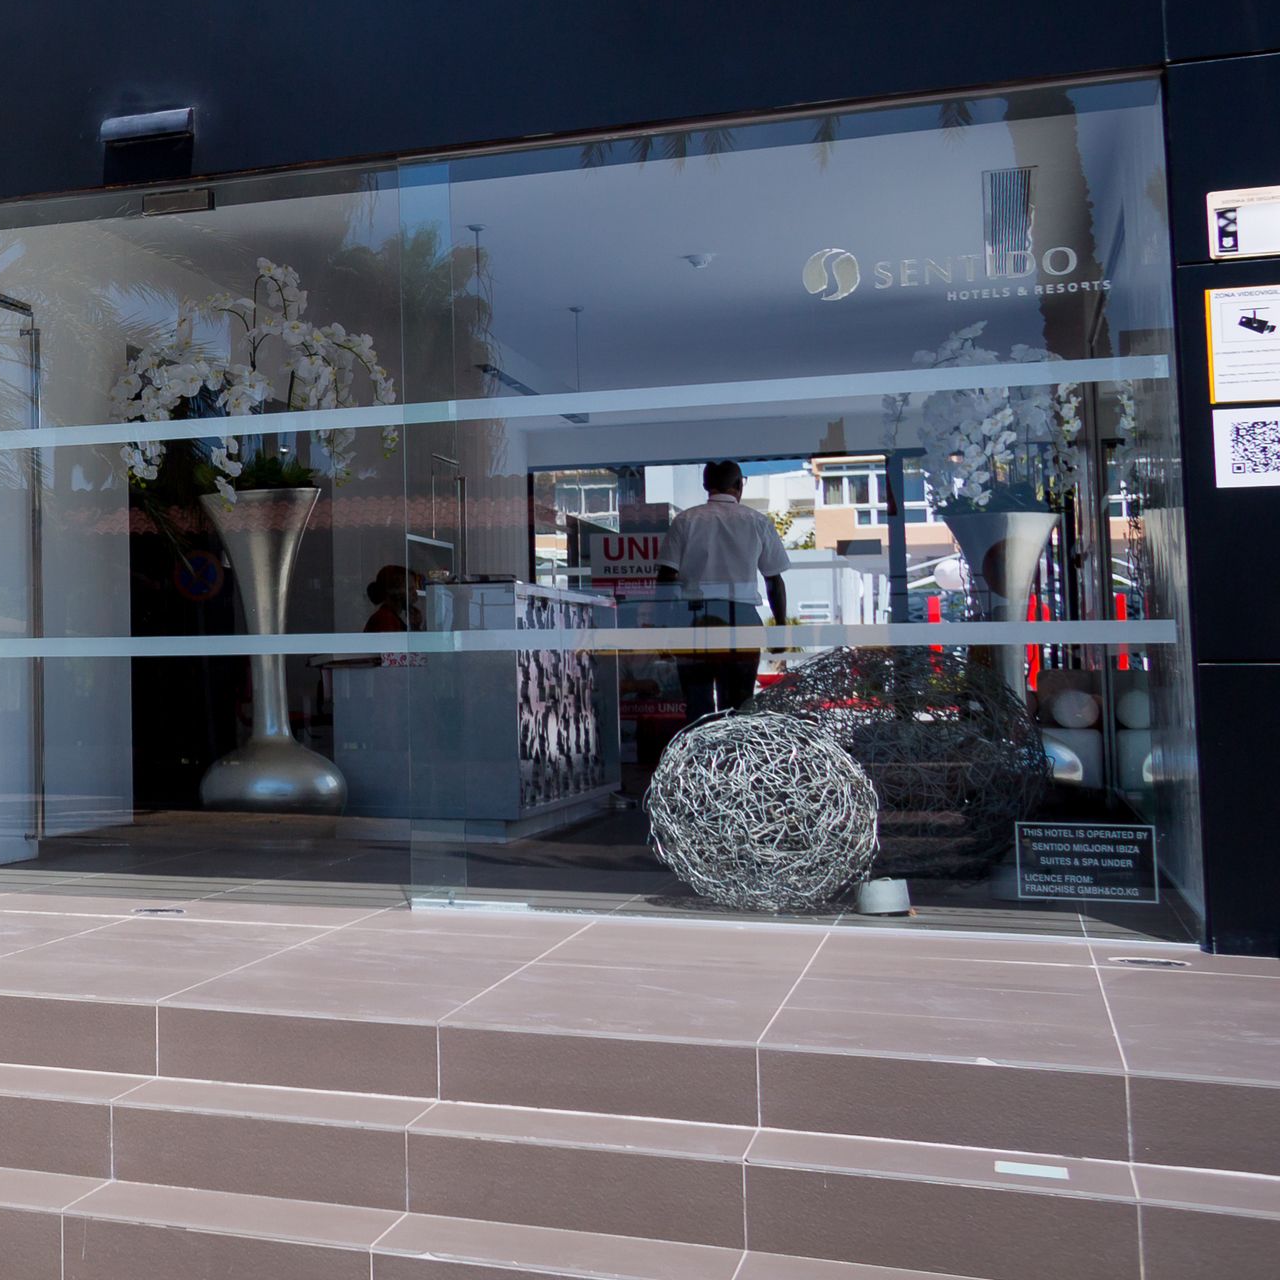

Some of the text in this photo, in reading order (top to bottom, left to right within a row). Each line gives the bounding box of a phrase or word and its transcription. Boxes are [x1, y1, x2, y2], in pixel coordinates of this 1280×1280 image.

[873, 246, 1078, 290] SENTIDO
[947, 280, 1112, 301] HOTELS & RESORTS
[1022, 828, 1148, 840] THIS HOTEL IS OPERATED BY
[1032, 842, 1139, 854] SENTIDO MIGJORN IBIZA
[1040, 856, 1133, 868] SUITES & SPA UNDER
[1025, 873, 1094, 884] LICENCE FROM:
[1025, 884, 1139, 897] FRANCHISE GMBH&CO.KG
